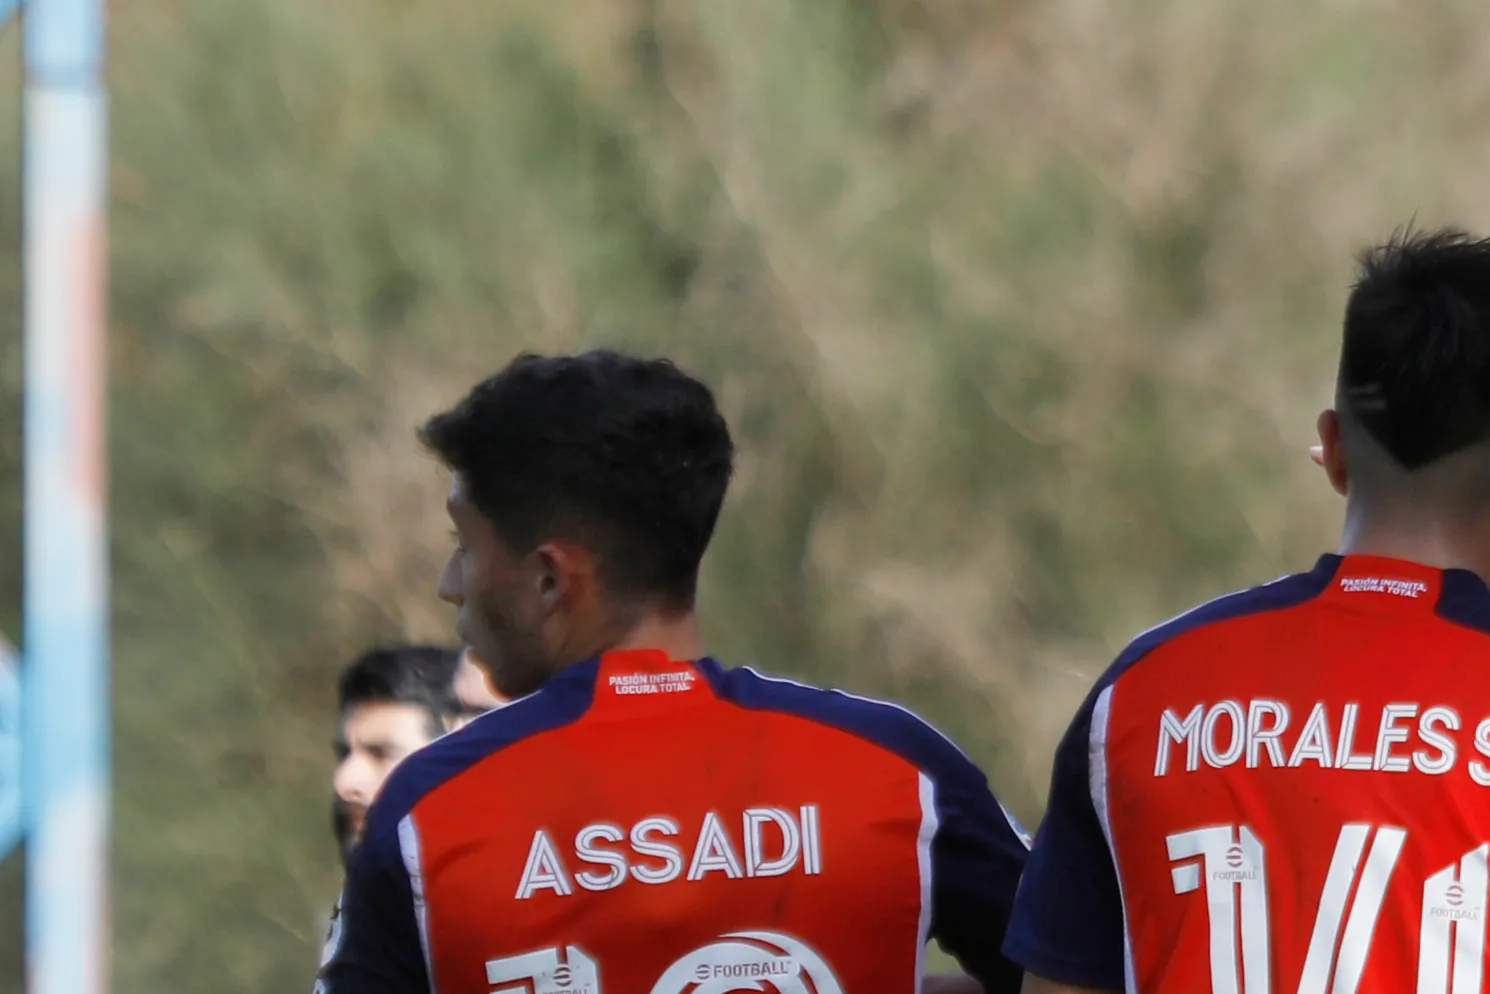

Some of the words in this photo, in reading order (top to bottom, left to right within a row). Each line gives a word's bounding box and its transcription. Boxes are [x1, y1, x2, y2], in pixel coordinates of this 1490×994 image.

[1387, 587, 1418, 597] TOTAL
[615, 684, 658, 695] LOCURA
[660, 681, 692, 692] TOTAL
[1154, 700, 1460, 777] MORALES
[515, 806, 820, 899] ASSADI
